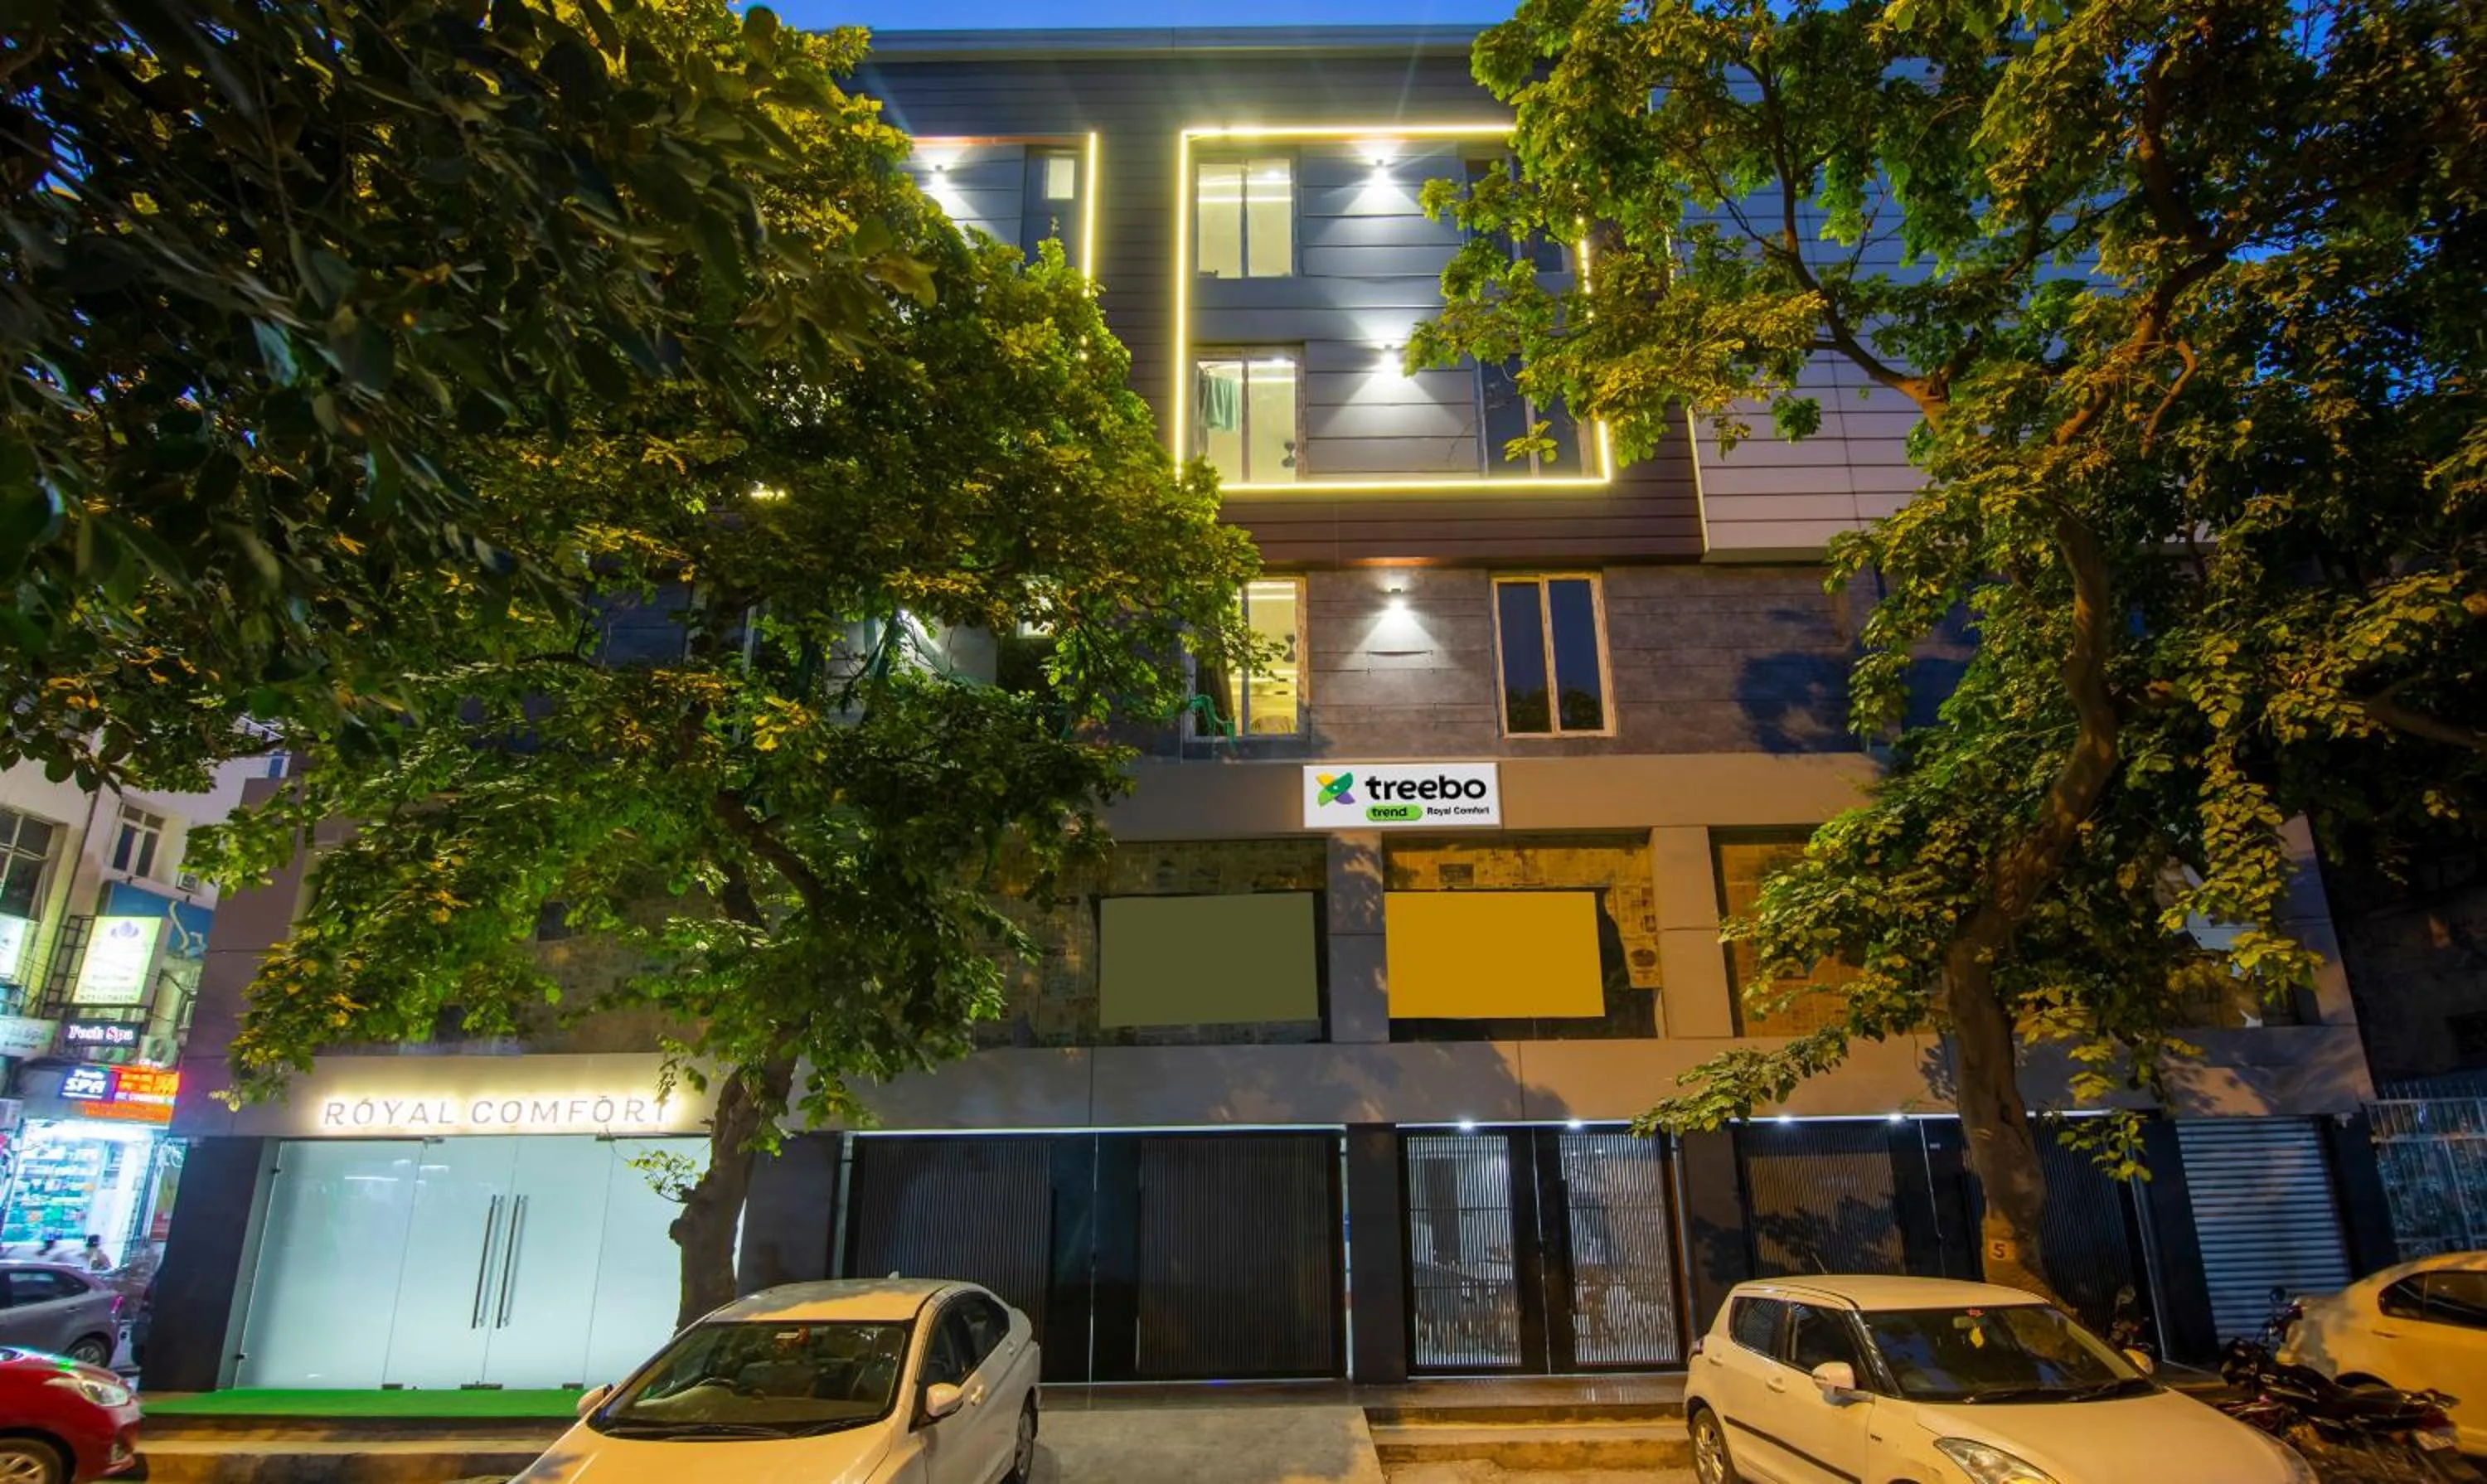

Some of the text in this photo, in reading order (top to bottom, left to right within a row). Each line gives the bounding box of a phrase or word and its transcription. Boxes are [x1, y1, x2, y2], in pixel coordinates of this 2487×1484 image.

[1365, 774, 1487, 800] treebo
[1372, 806, 1407, 817] trend
[1427, 806, 1490, 816] Royal Comfort
[64, 1078, 107, 1094] SPA
[324, 1099, 455, 1125] ROYAL
[1993, 1243, 2006, 1259] 5
